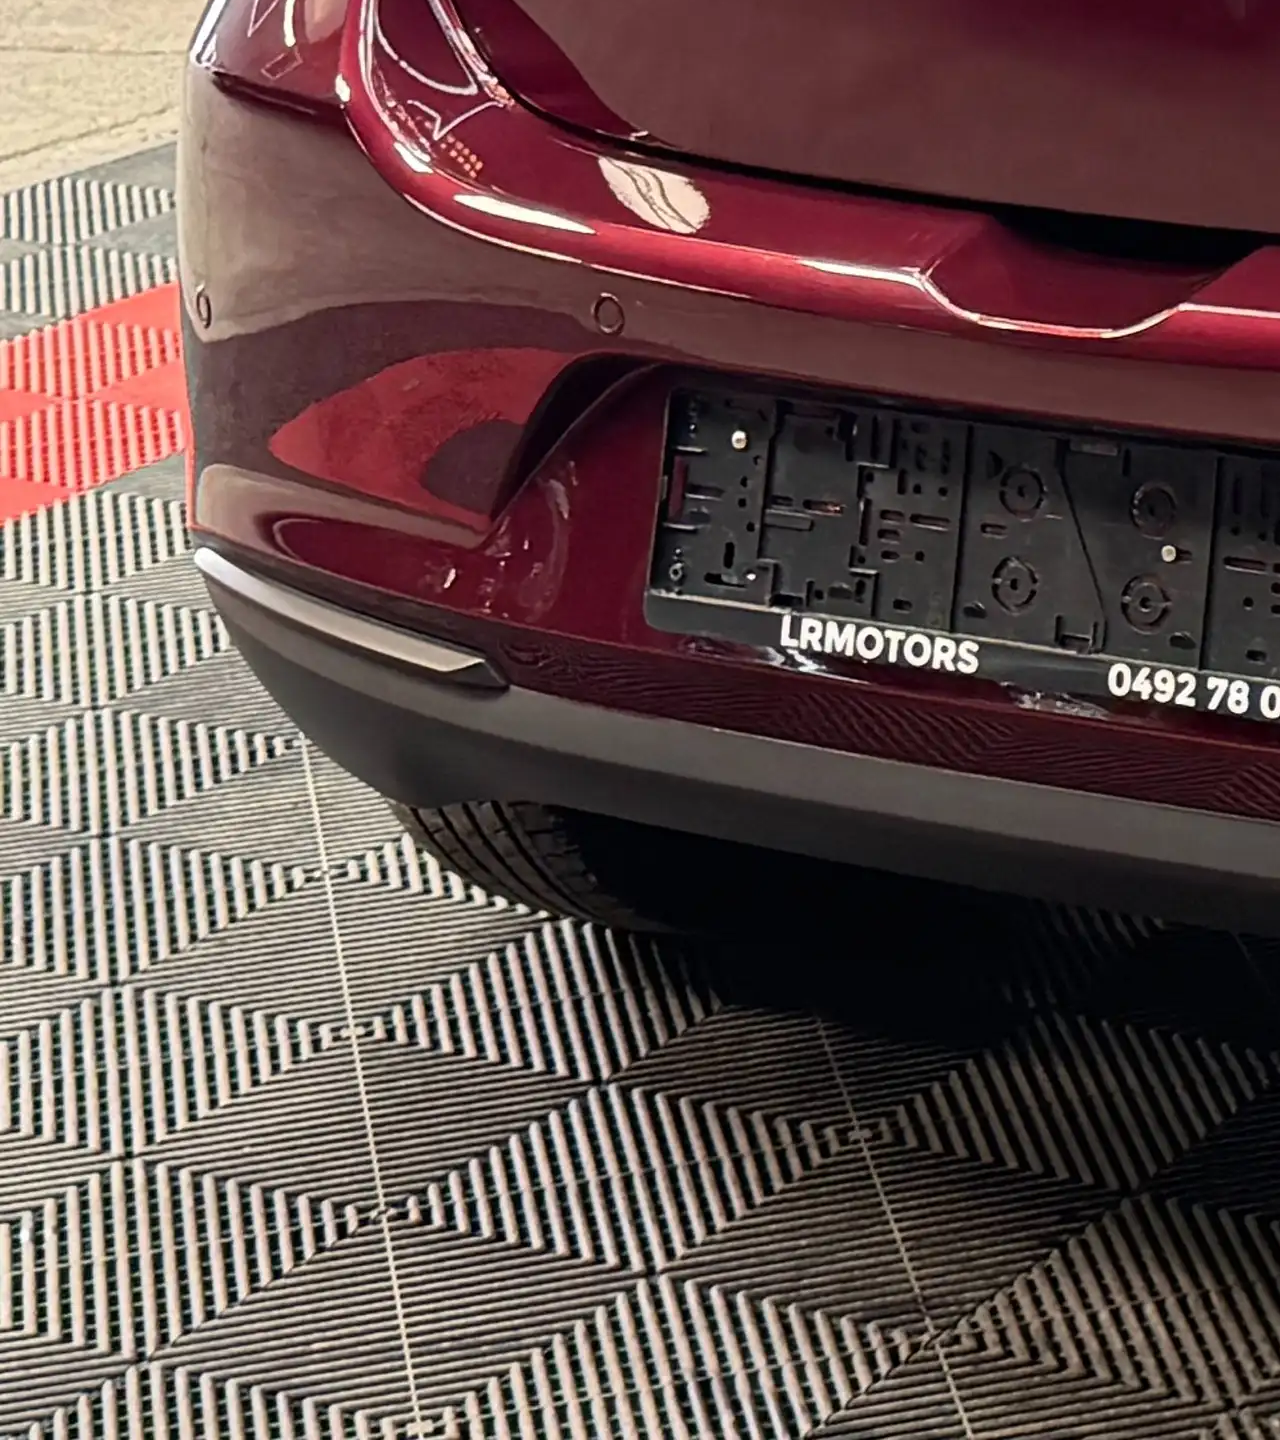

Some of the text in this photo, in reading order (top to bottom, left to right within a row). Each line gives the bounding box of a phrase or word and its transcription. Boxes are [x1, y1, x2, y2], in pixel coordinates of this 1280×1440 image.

[780, 614, 980, 675] LRMOTORS
[1107, 662, 1197, 708] 0492
[1206, 676, 1250, 714] 78
